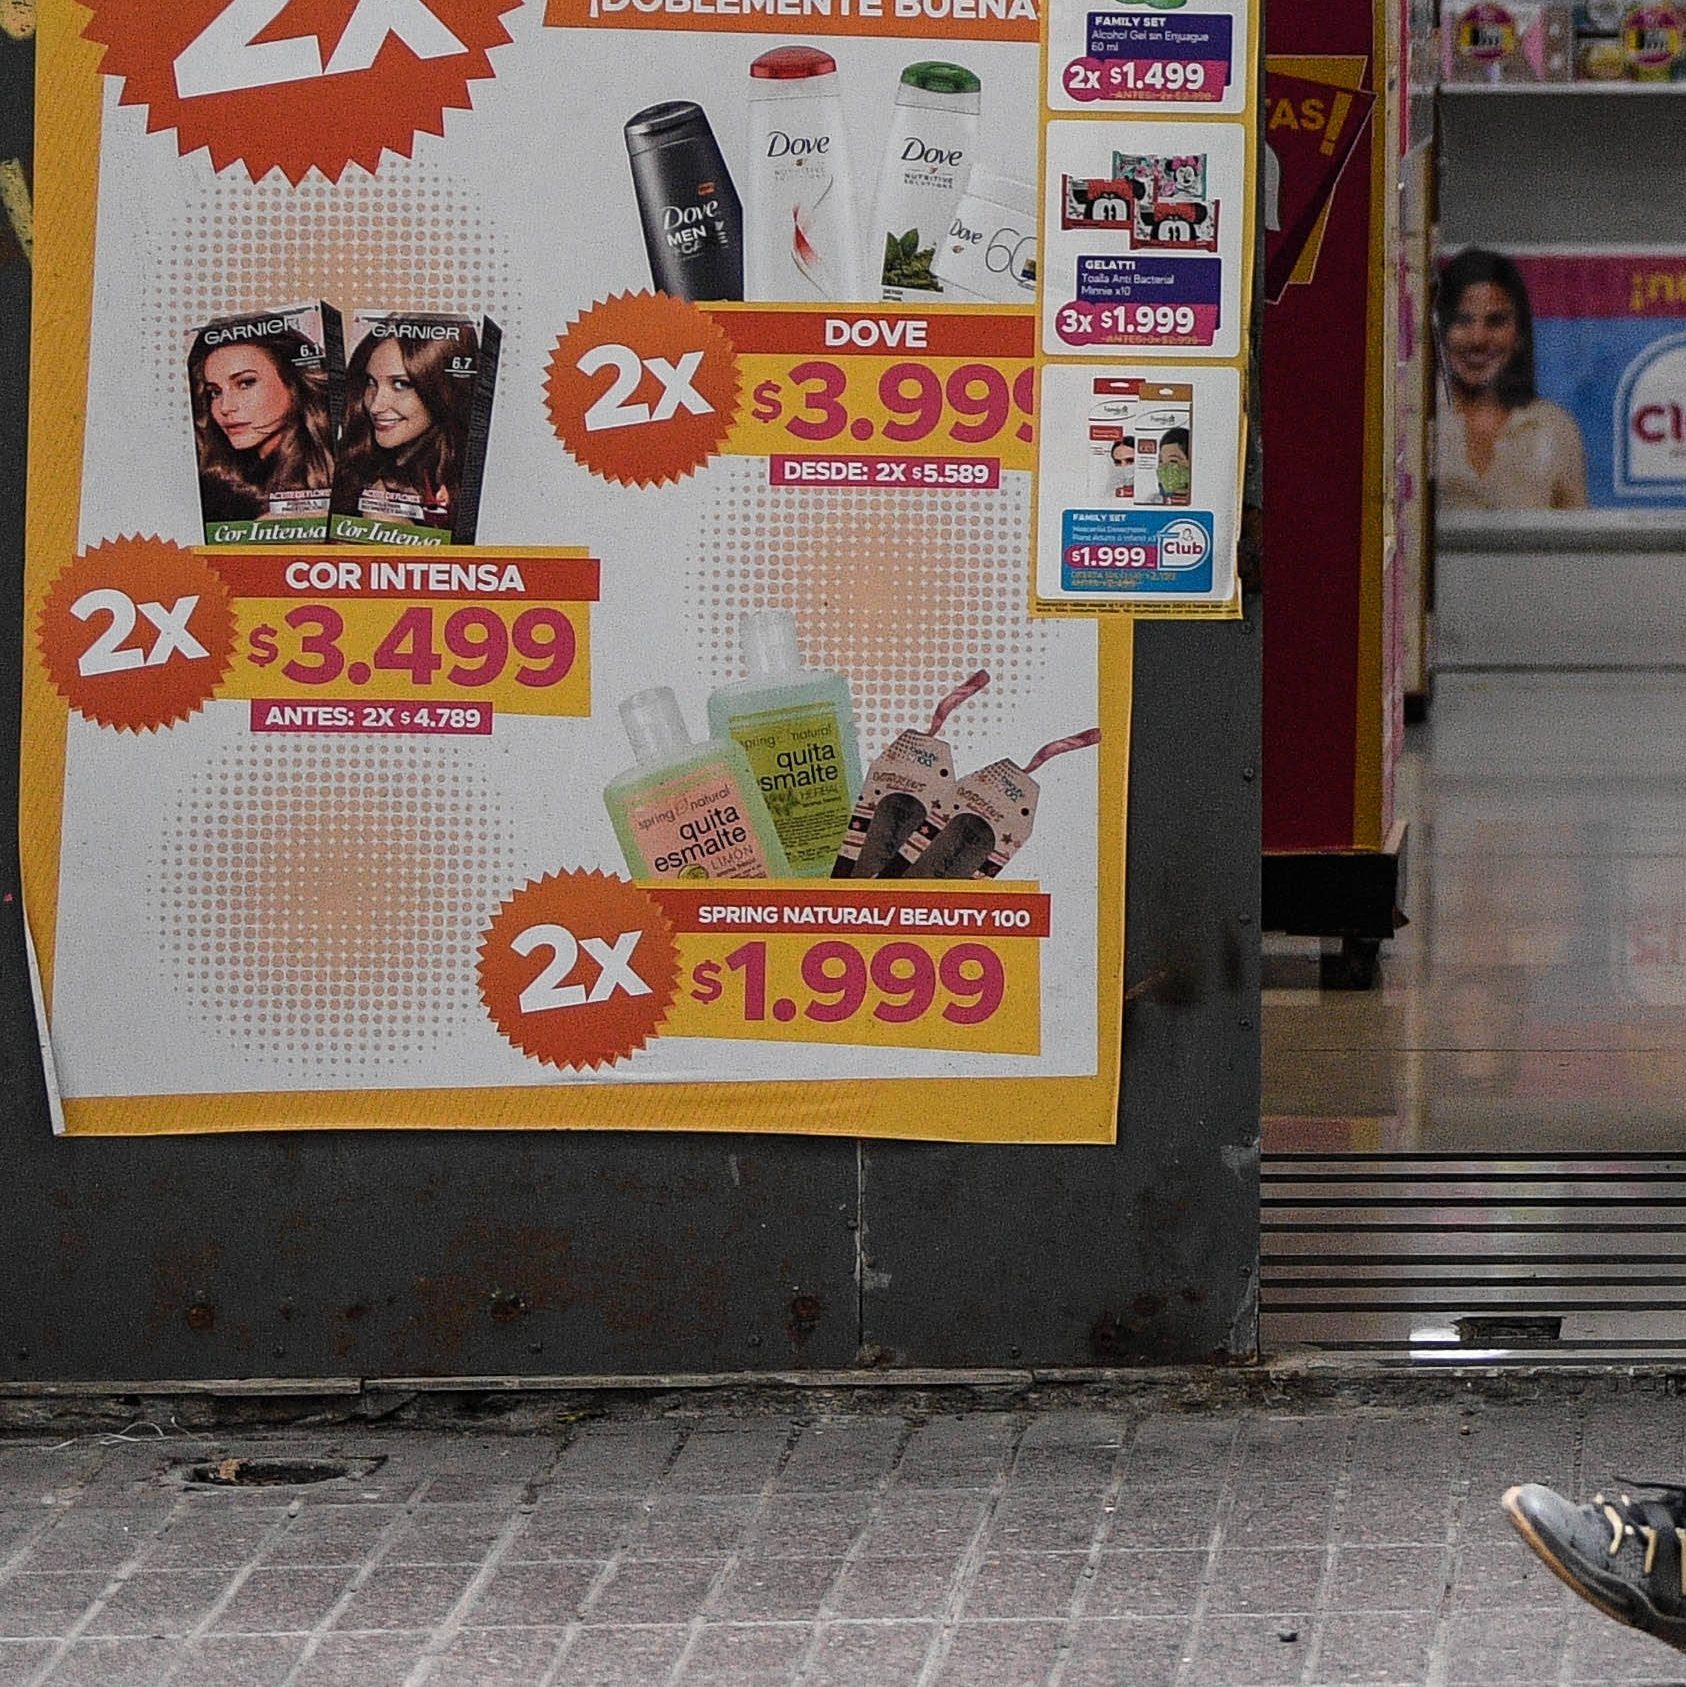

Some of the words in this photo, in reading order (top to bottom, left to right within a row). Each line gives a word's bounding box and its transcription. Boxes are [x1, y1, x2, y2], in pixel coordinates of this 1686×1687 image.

[1110, 62, 1205, 90] $1.499
[766, 130, 830, 159] Dove
[824, 320, 928, 348] DOVE
[1100, 307, 1194, 334] $1.999
[784, 462, 869, 482] DESDE:
[874, 463, 907, 482] 2X
[911, 463, 990, 484] $5.589
[1071, 548, 1146, 566] $1.999
[1164, 541, 1203, 556] Club
[285, 562, 361, 591] COR
[369, 563, 526, 592] INTENSA
[246, 604, 577, 689] $3.499
[266, 706, 355, 727] ANTES:
[361, 707, 395, 727] 2X
[401, 707, 481, 728] $4.789
[680, 805, 740, 841] quita
[654, 826, 747, 873] esmalte
[697, 905, 777, 927] SPRING
[781, 906, 895, 928] NATURAL/
[899, 907, 987, 928] BEAUTY
[991, 909, 1030, 928] 100
[689, 941, 1006, 1025] $1.999
